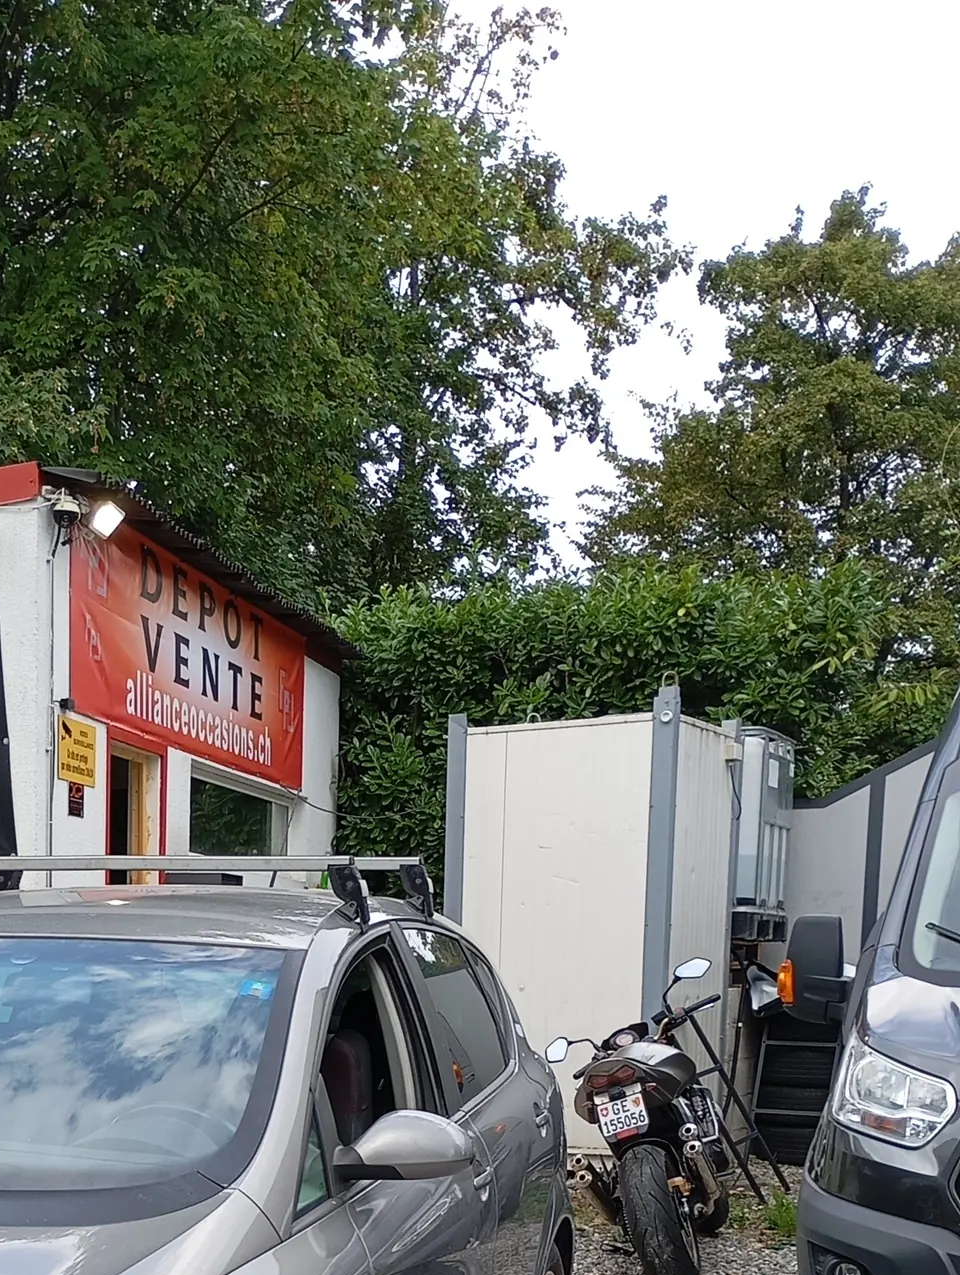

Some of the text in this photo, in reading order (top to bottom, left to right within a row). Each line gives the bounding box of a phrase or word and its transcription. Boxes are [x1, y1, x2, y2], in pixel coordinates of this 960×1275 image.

[140, 613, 263, 721] VENTE
[125, 670, 271, 767] allianceoccasions.ch
[603, 1110, 646, 1134] 155056
[611, 1099, 631, 1116] GE
